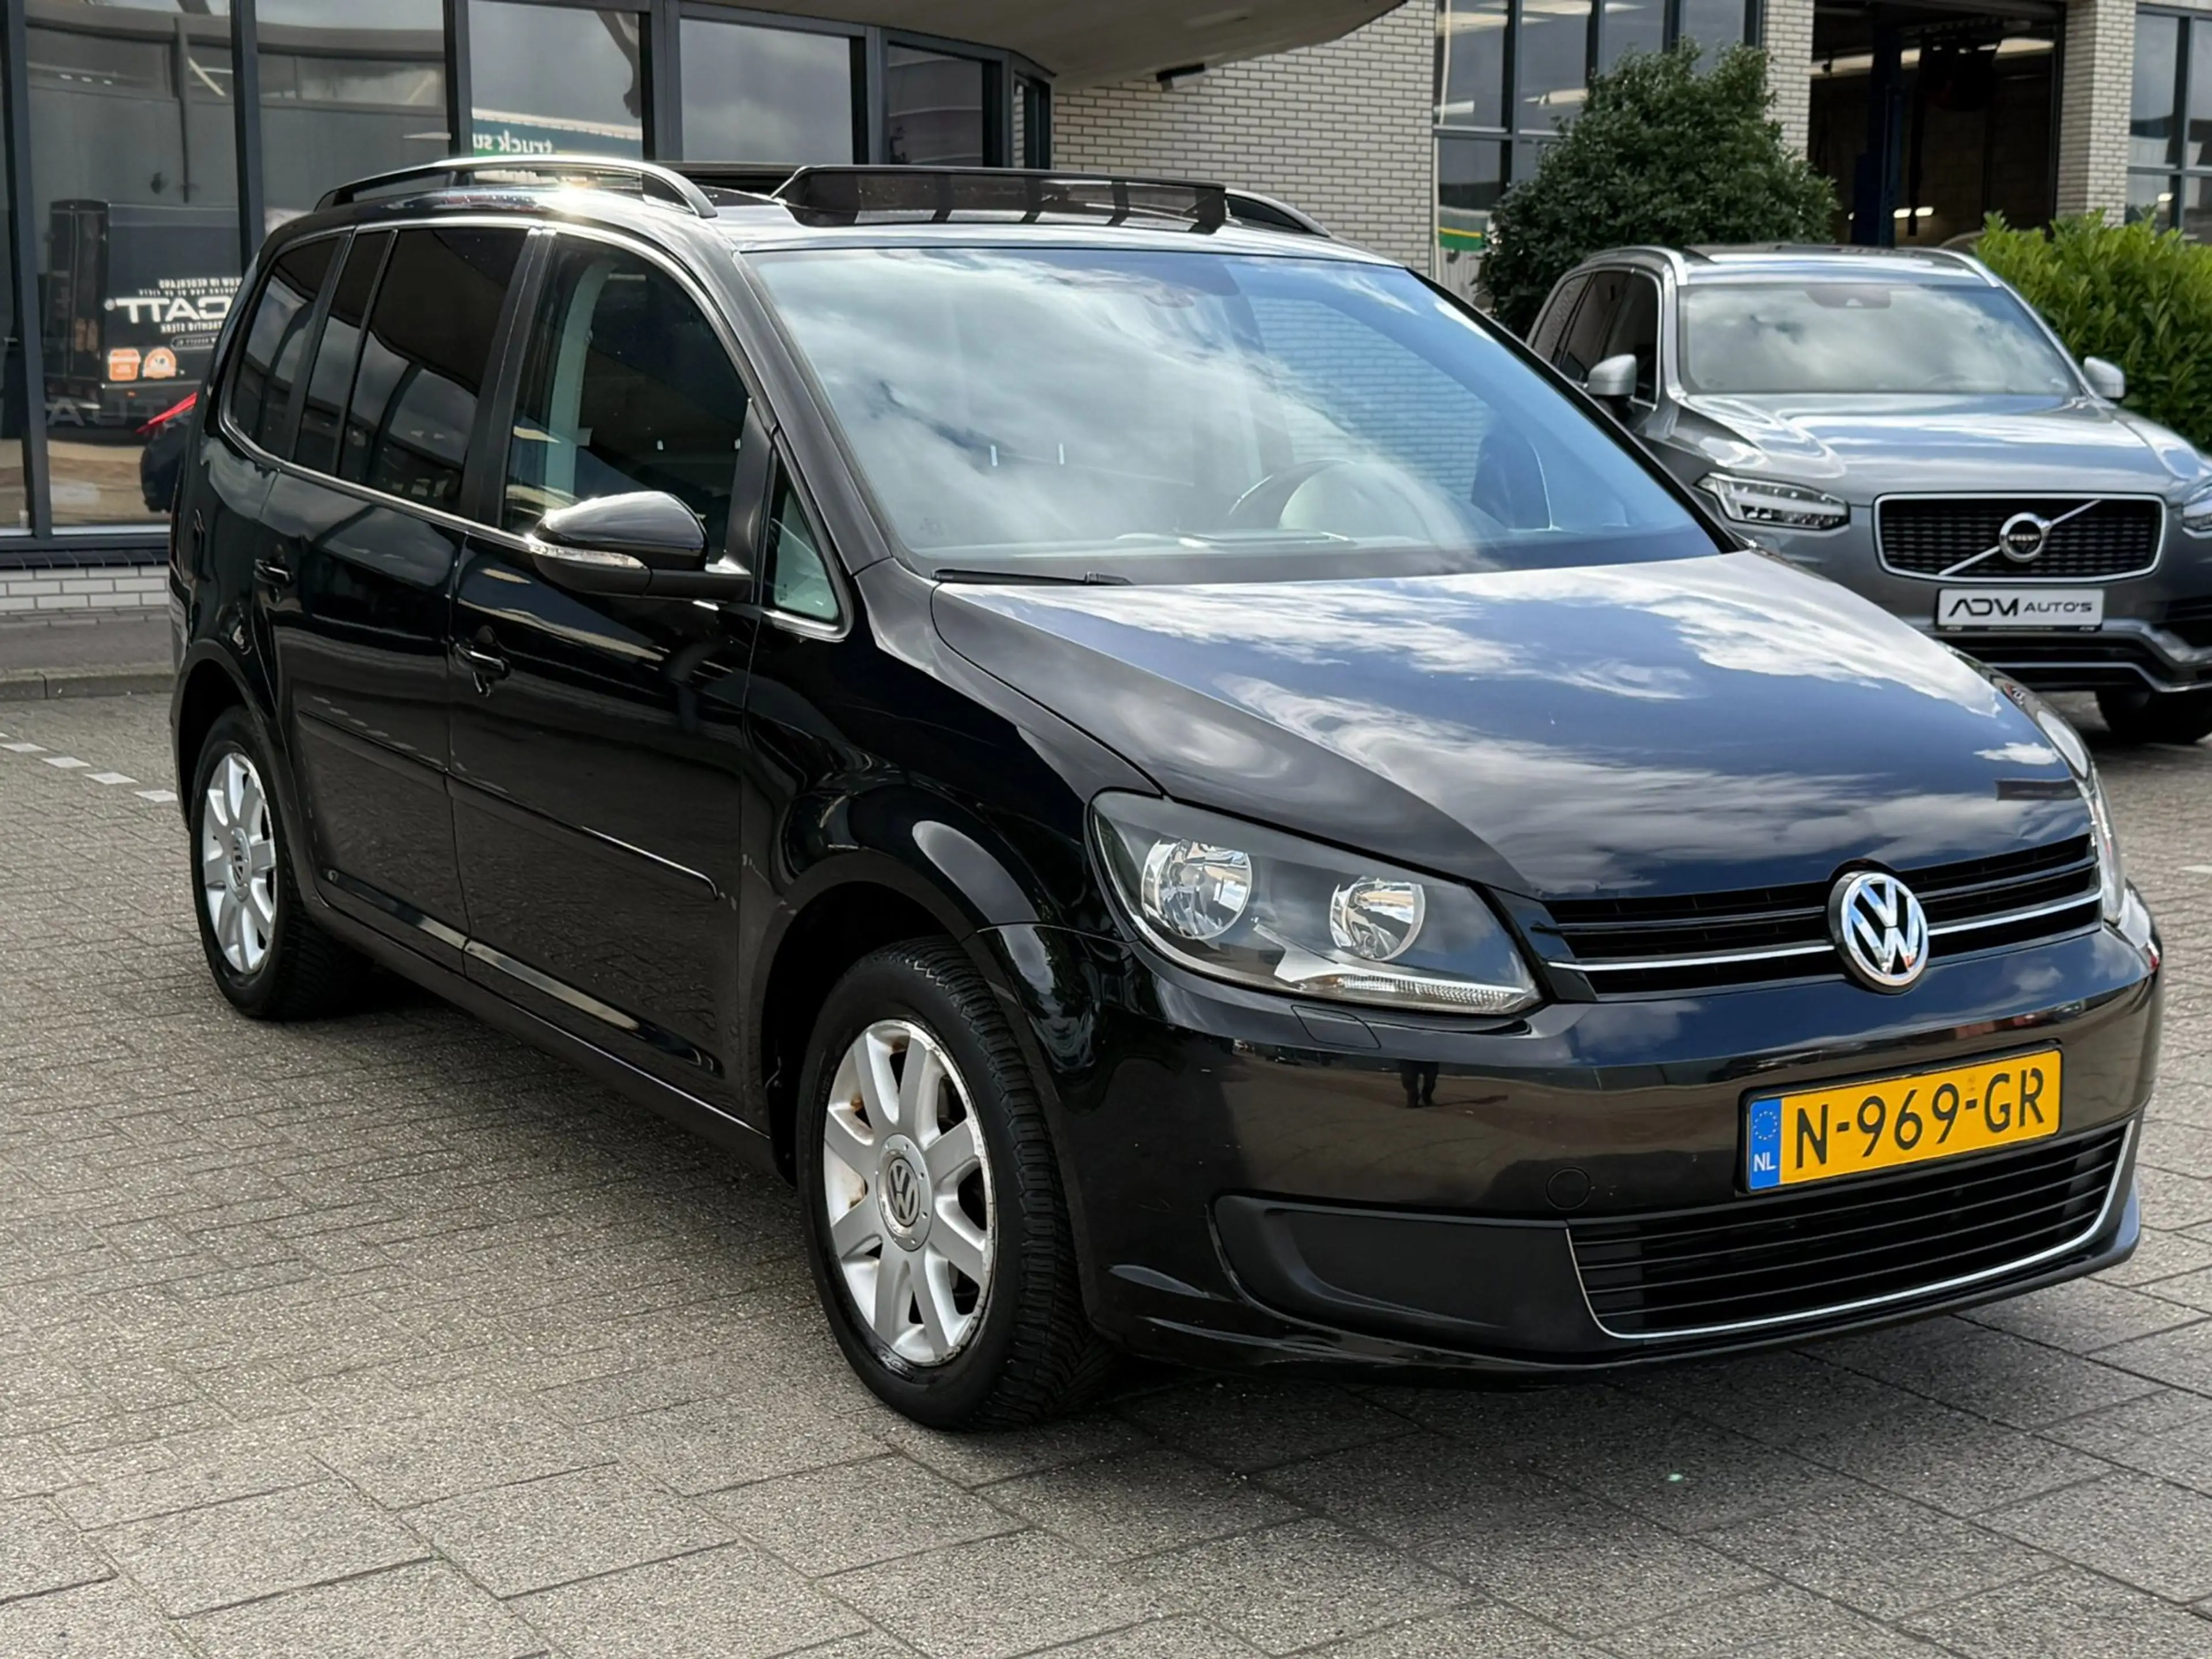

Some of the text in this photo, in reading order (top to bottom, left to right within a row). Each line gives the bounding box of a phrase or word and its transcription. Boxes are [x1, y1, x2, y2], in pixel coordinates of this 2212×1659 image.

[1948, 597, 2093, 618] ADM AUTO'S
[1794, 1067, 2045, 1170] N-969-GR
[1753, 1152, 1777, 1172] NL
